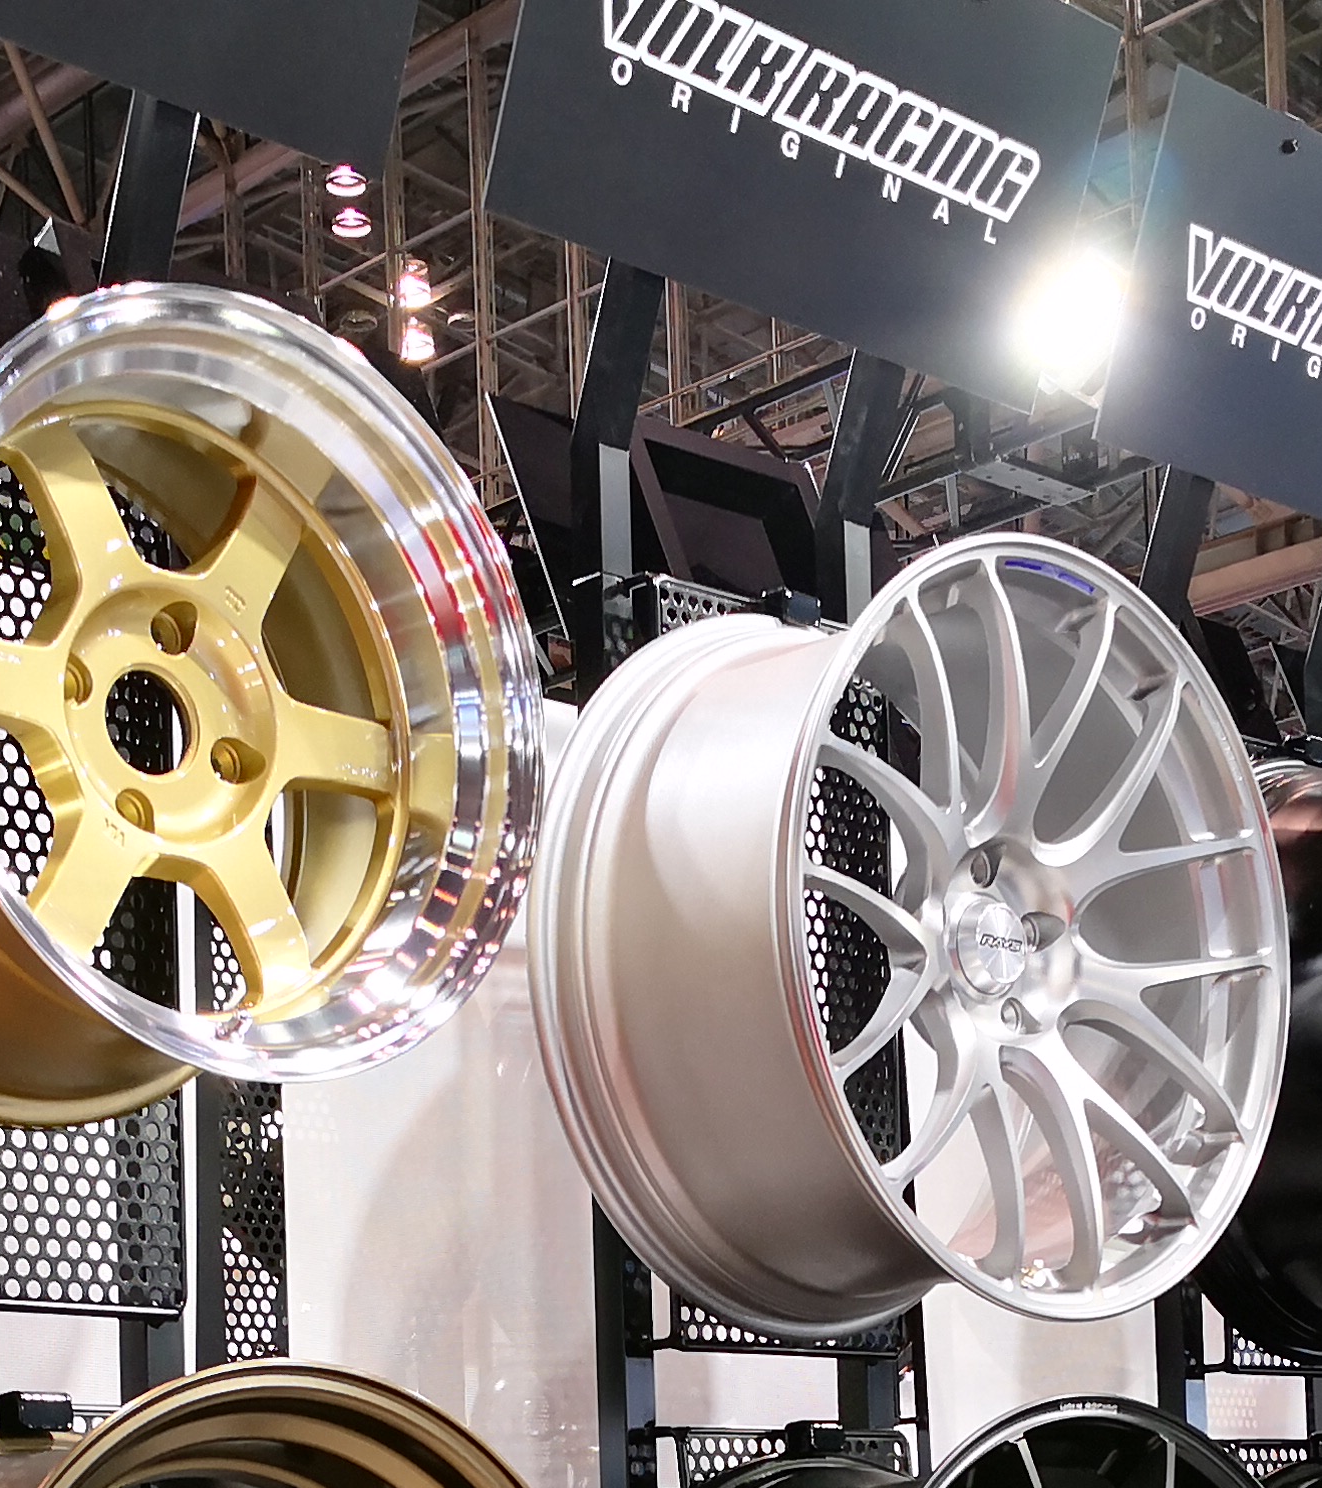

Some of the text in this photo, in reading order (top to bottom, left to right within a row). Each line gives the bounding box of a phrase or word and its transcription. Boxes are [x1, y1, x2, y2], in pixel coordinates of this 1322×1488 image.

[604, 0, 1041, 223] VOLK RACING
[611, 56, 996, 245] ORIGINAL
